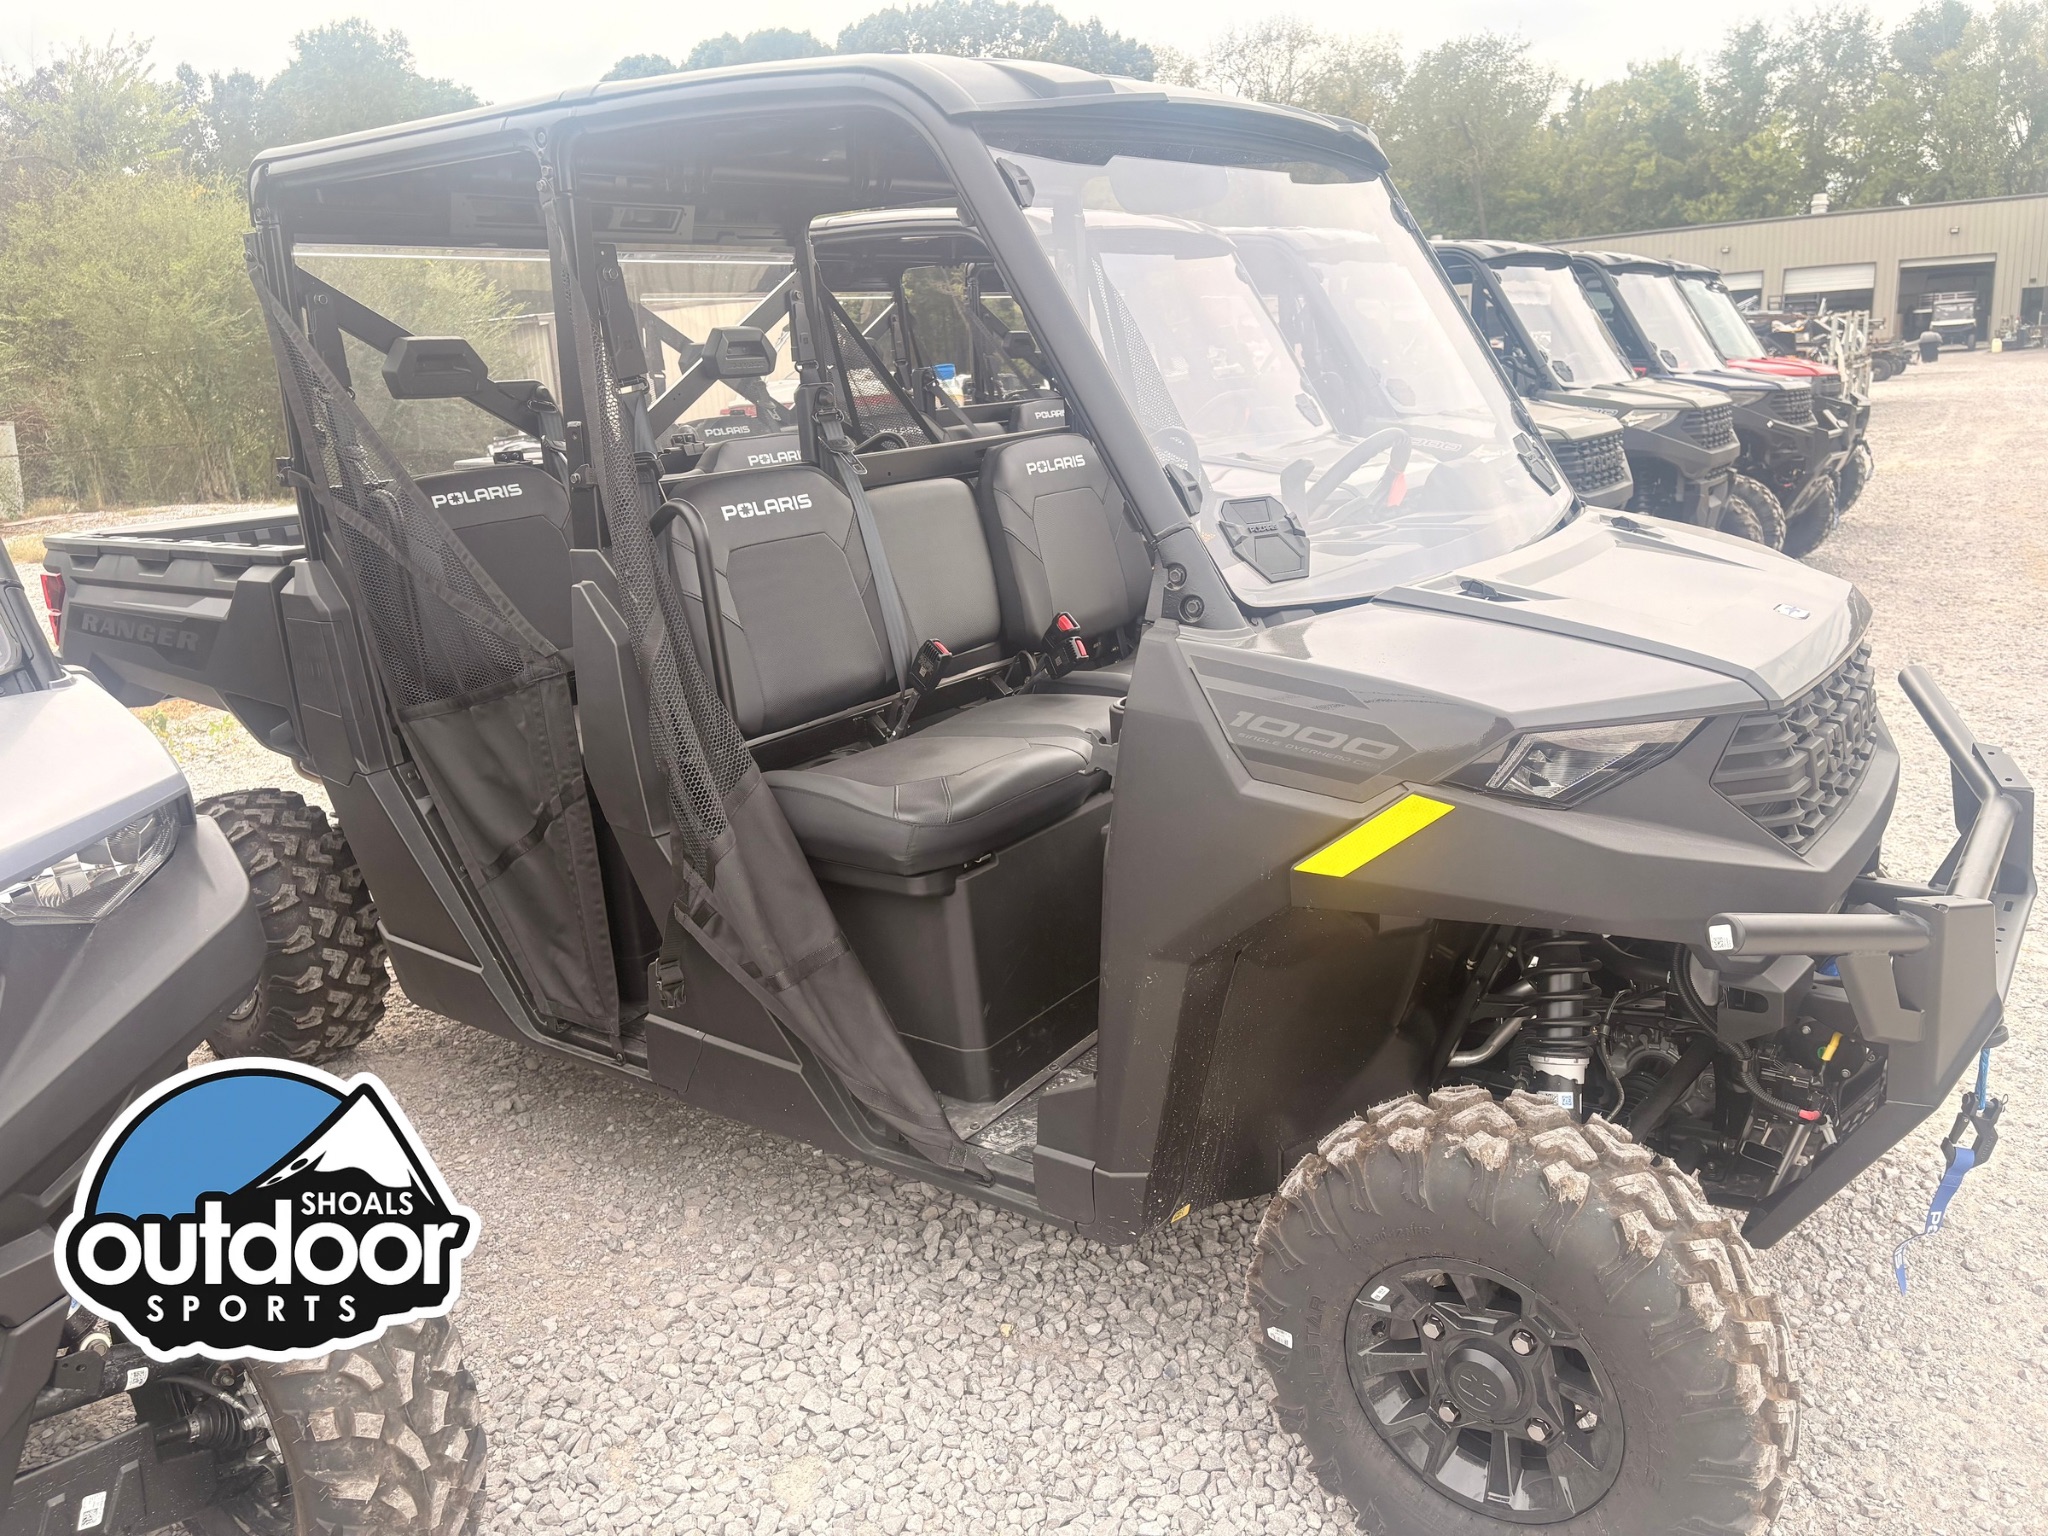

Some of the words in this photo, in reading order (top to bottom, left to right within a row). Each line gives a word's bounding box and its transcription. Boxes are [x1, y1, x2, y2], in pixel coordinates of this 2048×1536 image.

[1034, 409, 1065, 419] POLARI
[704, 425, 750, 437] POLARIS
[747, 449, 802, 466] POLARI
[1026, 454, 1086, 475] POLARIS
[431, 483, 523, 509] POLARIS
[720, 493, 813, 521] POLARIS
[81, 612, 199, 651] RANGER
[1229, 710, 1399, 761] 1000
[1237, 732, 1280, 746] SINGLE
